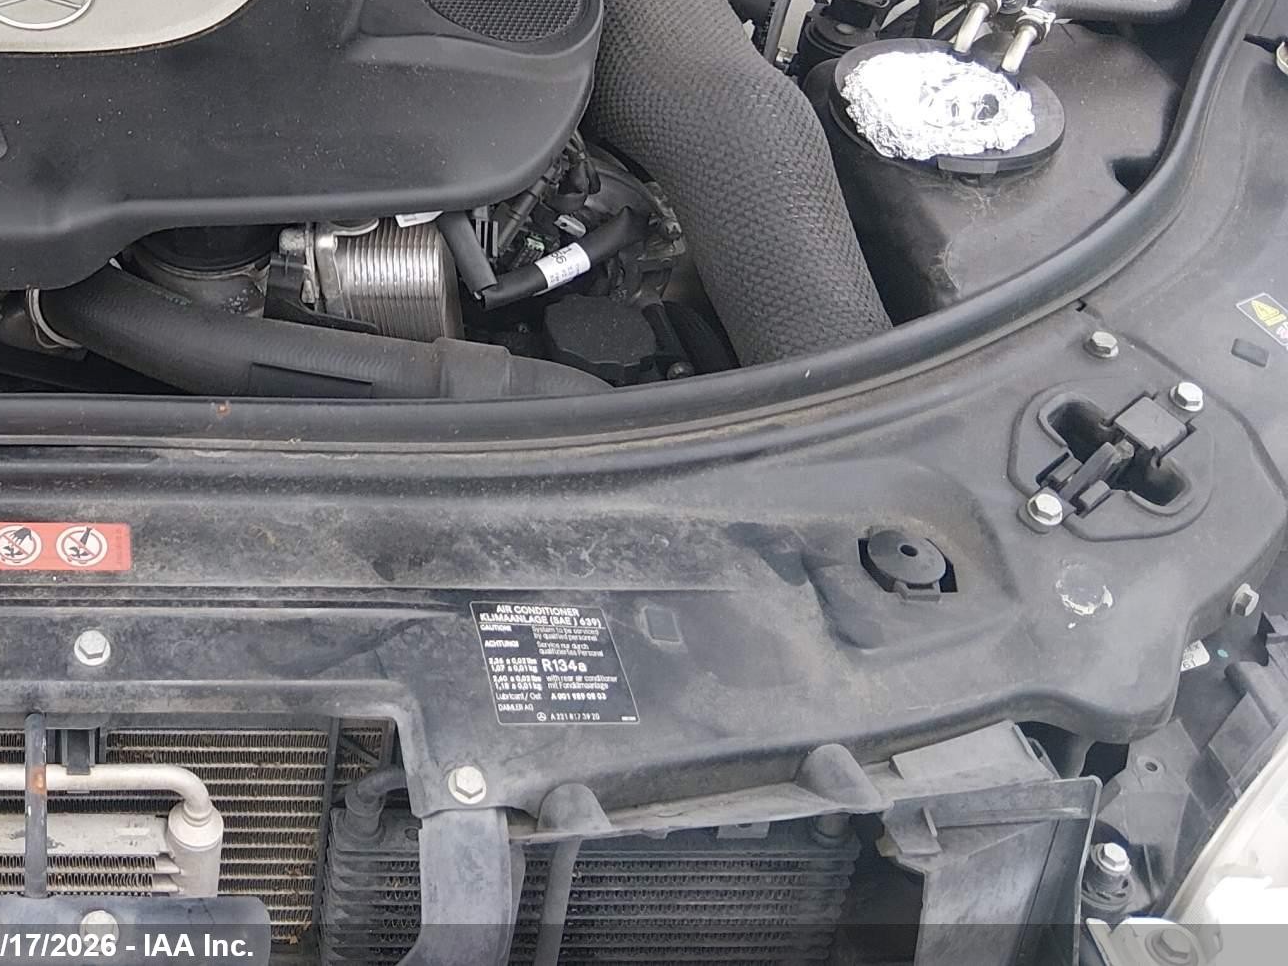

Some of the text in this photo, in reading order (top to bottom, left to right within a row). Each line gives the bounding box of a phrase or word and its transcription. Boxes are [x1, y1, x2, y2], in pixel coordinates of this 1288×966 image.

[496, 604, 579, 617] AIR CONDITIONER
[479, 613, 548, 625] KLIMAANLAGE
[550, 616, 572, 626] (SAE
[579, 617, 602, 628] 639)
[541, 659, 588, 672] R134a
[498, 703, 524, 711] DAIMLER
